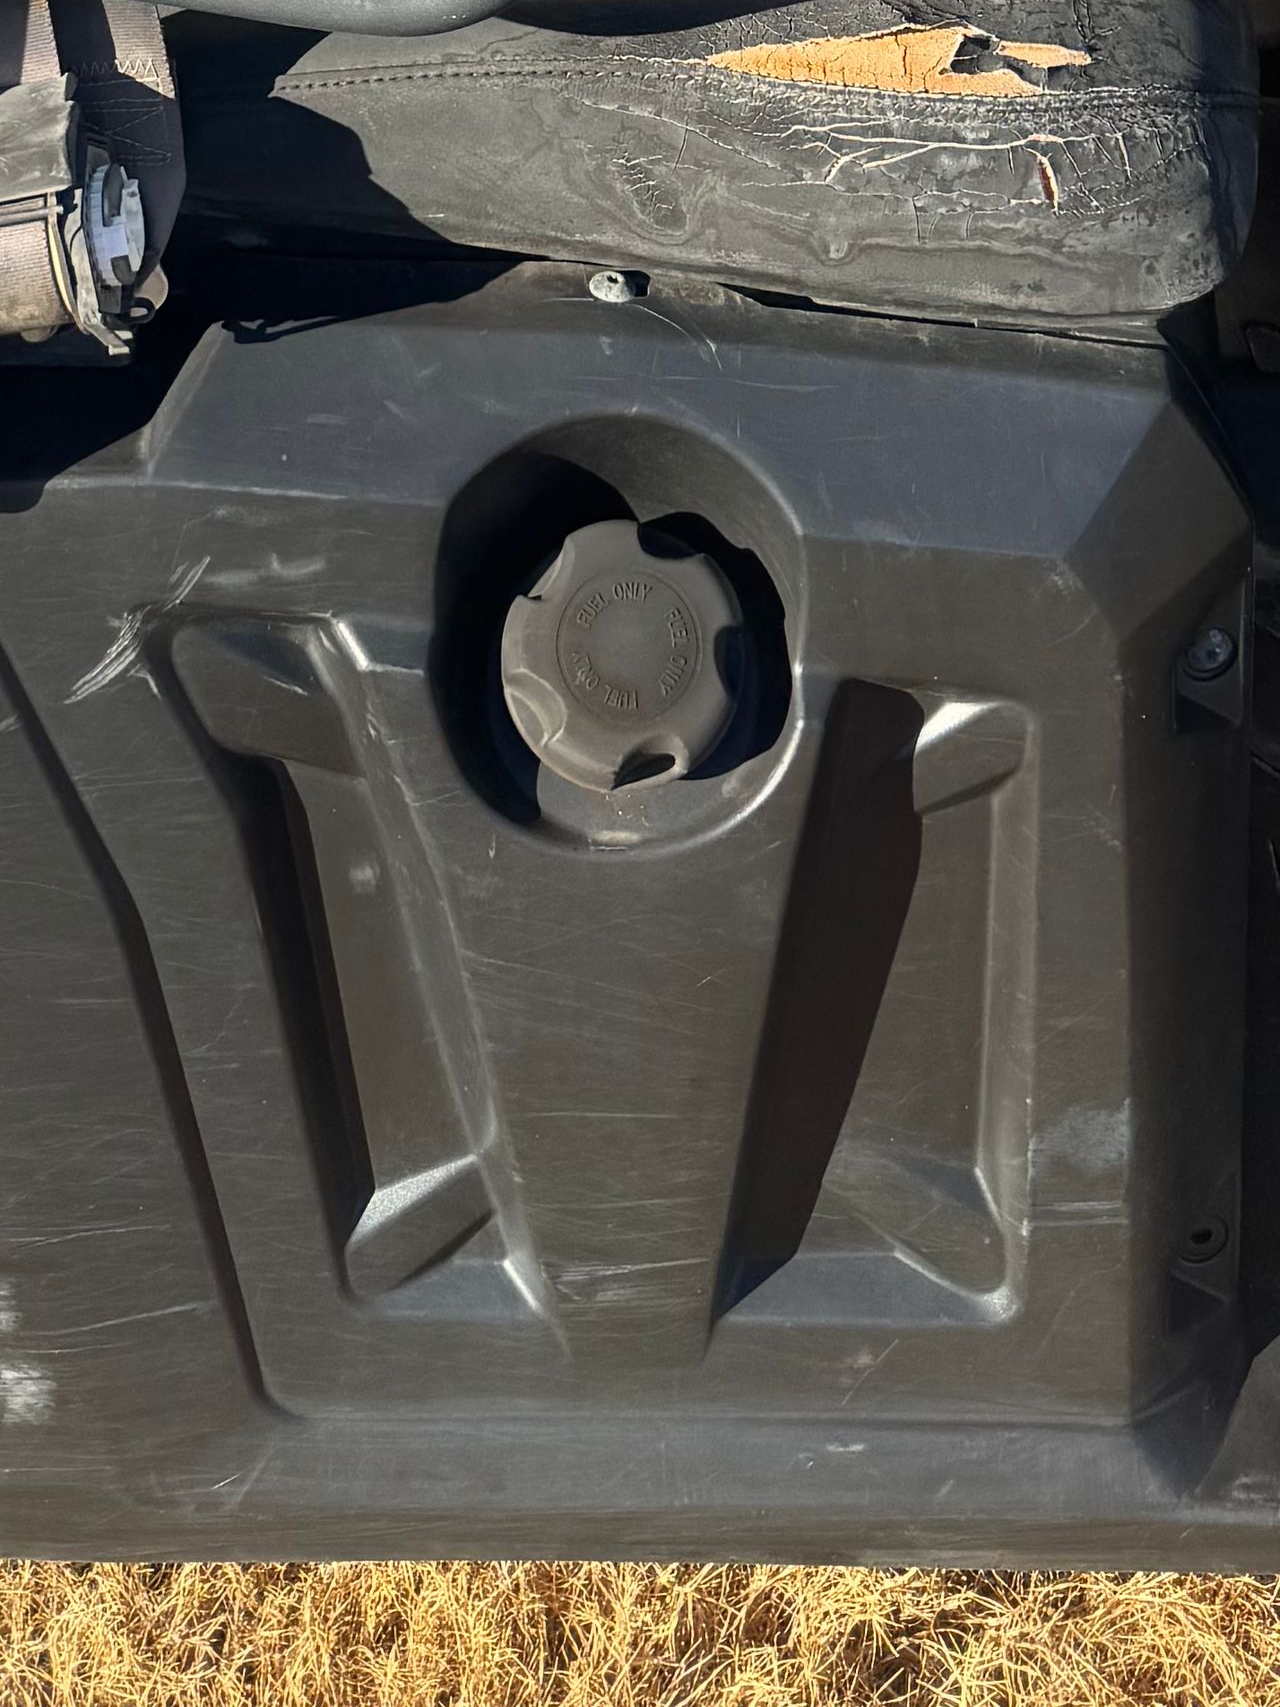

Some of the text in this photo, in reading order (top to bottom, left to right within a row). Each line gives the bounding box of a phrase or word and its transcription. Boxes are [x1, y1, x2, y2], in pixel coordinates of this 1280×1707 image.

[576, 581, 654, 628] FUEL ONLY
[664, 607, 690, 648] FUEL
